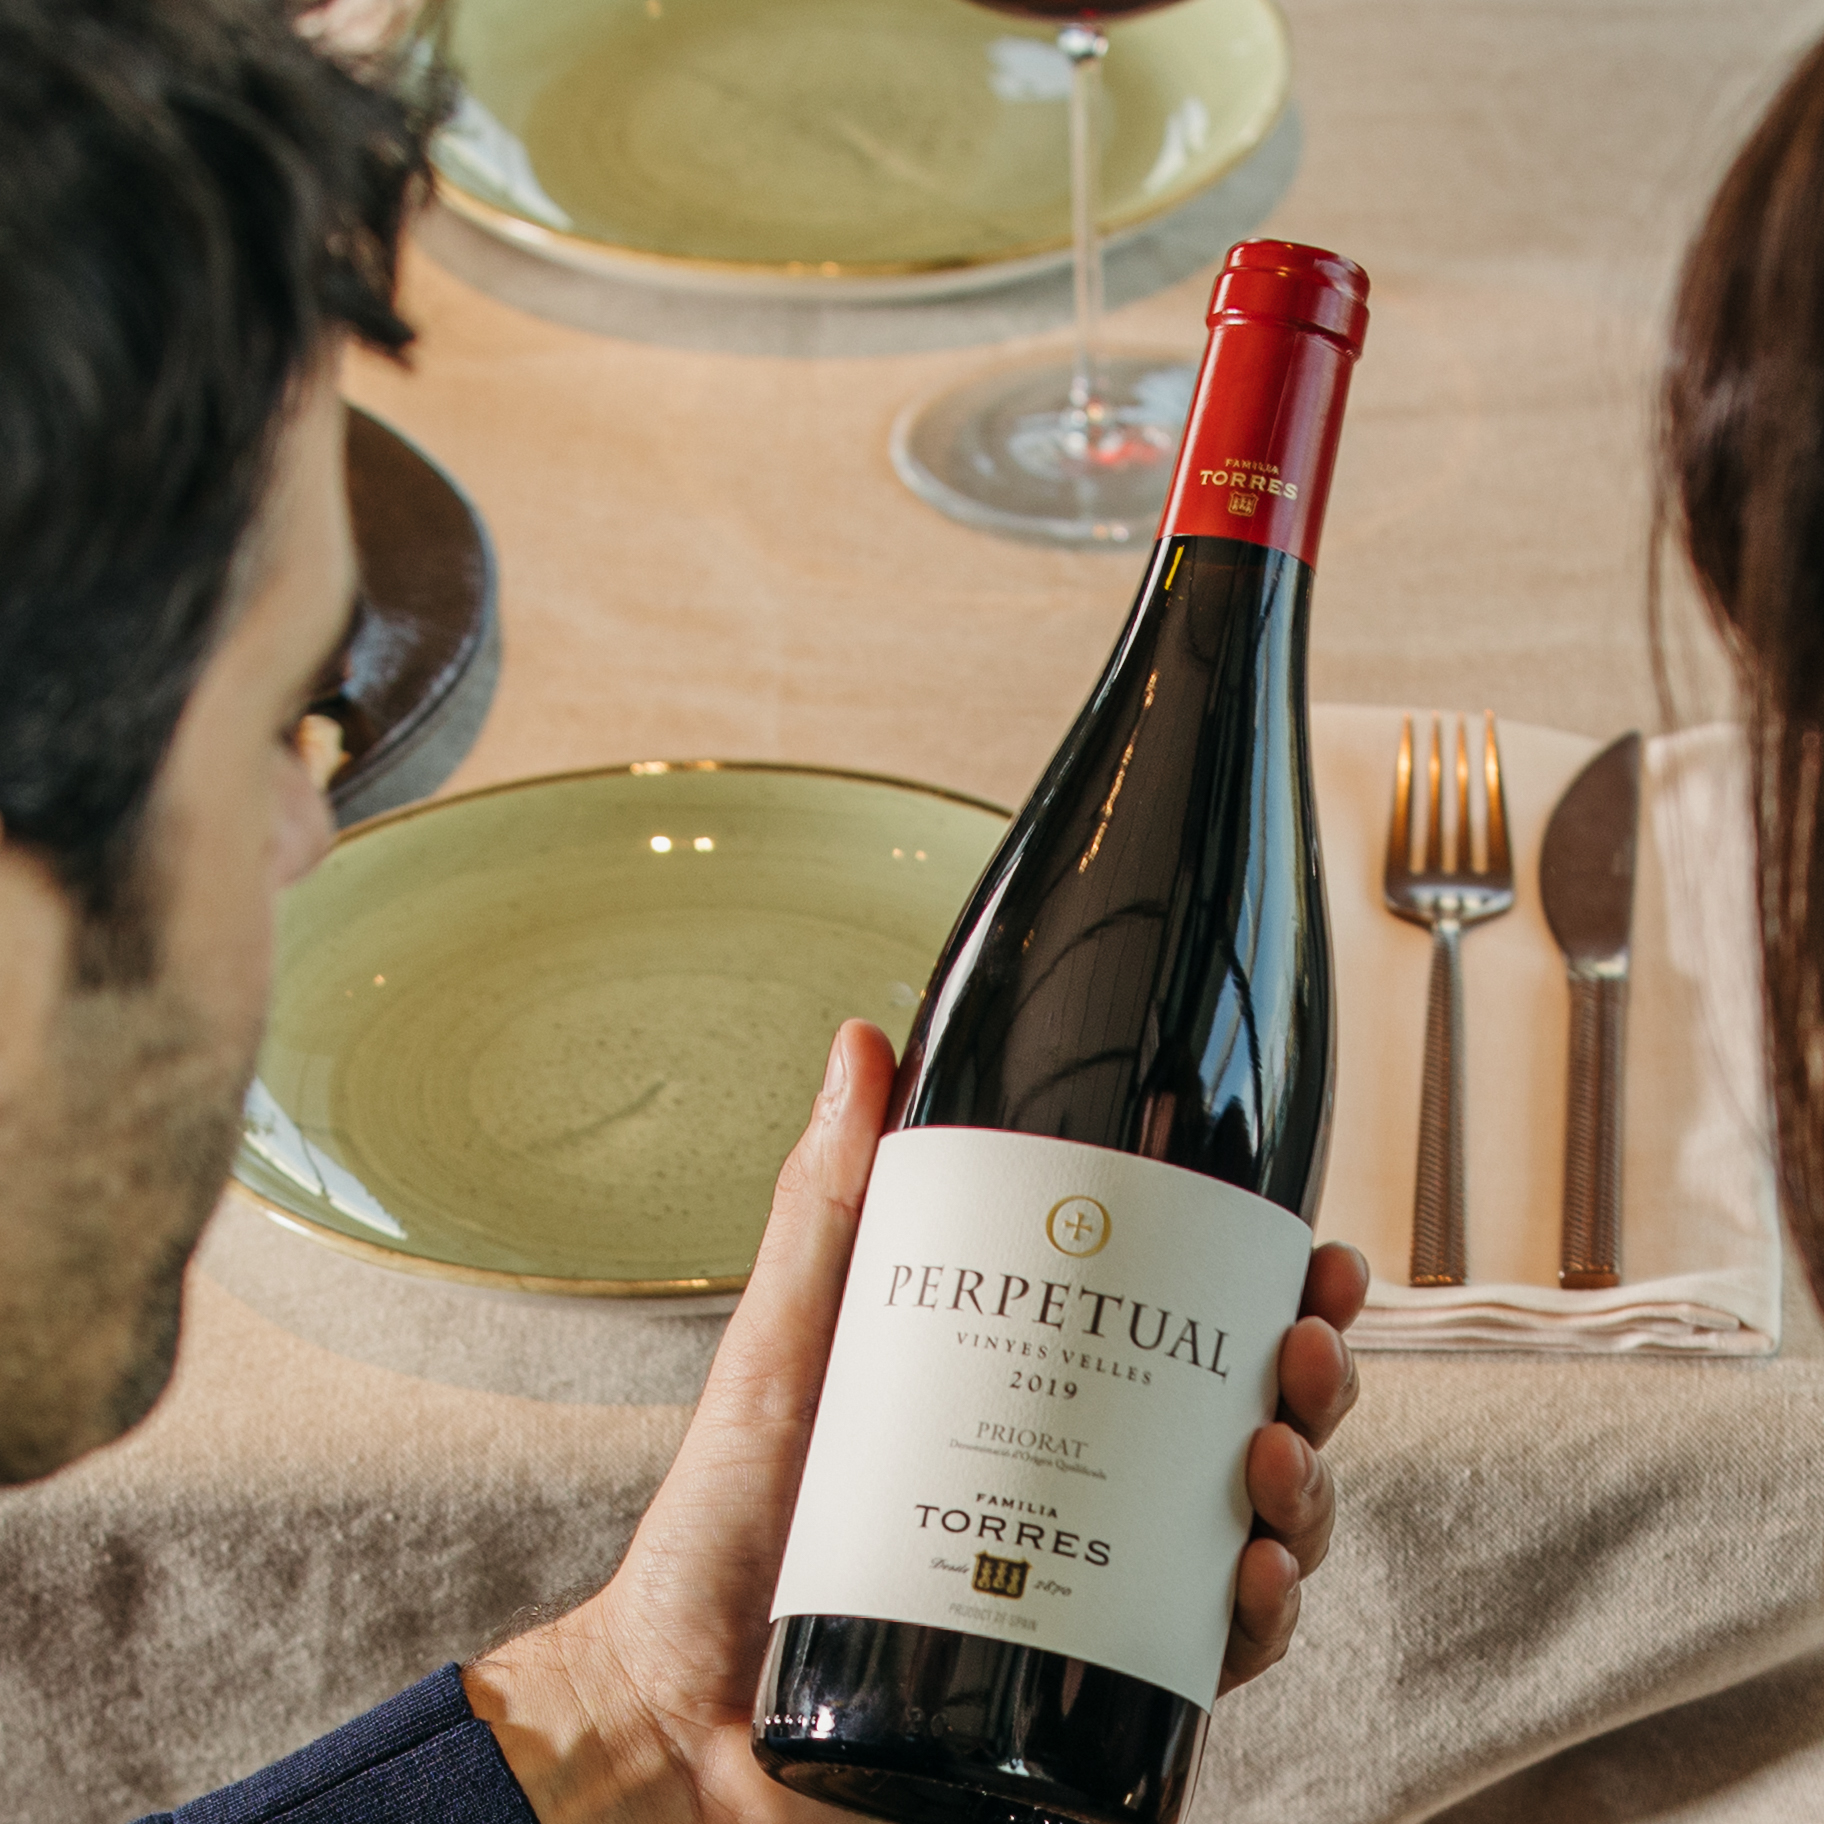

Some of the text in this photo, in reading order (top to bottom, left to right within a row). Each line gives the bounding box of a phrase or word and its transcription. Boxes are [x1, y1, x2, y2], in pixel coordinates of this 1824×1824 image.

[1225, 458, 1280, 475] FAMILIA
[1200, 470, 1298, 501] TORRES
[884, 1264, 1231, 1381] PERPETUAL
[956, 1331, 1152, 1386] VINYES VELLES
[1010, 1371, 1078, 1399] 2019
[976, 1421, 1089, 1459] PRIORAT
[976, 1492, 1058, 1518] FAMILIA
[914, 1504, 1111, 1566] TORRES
